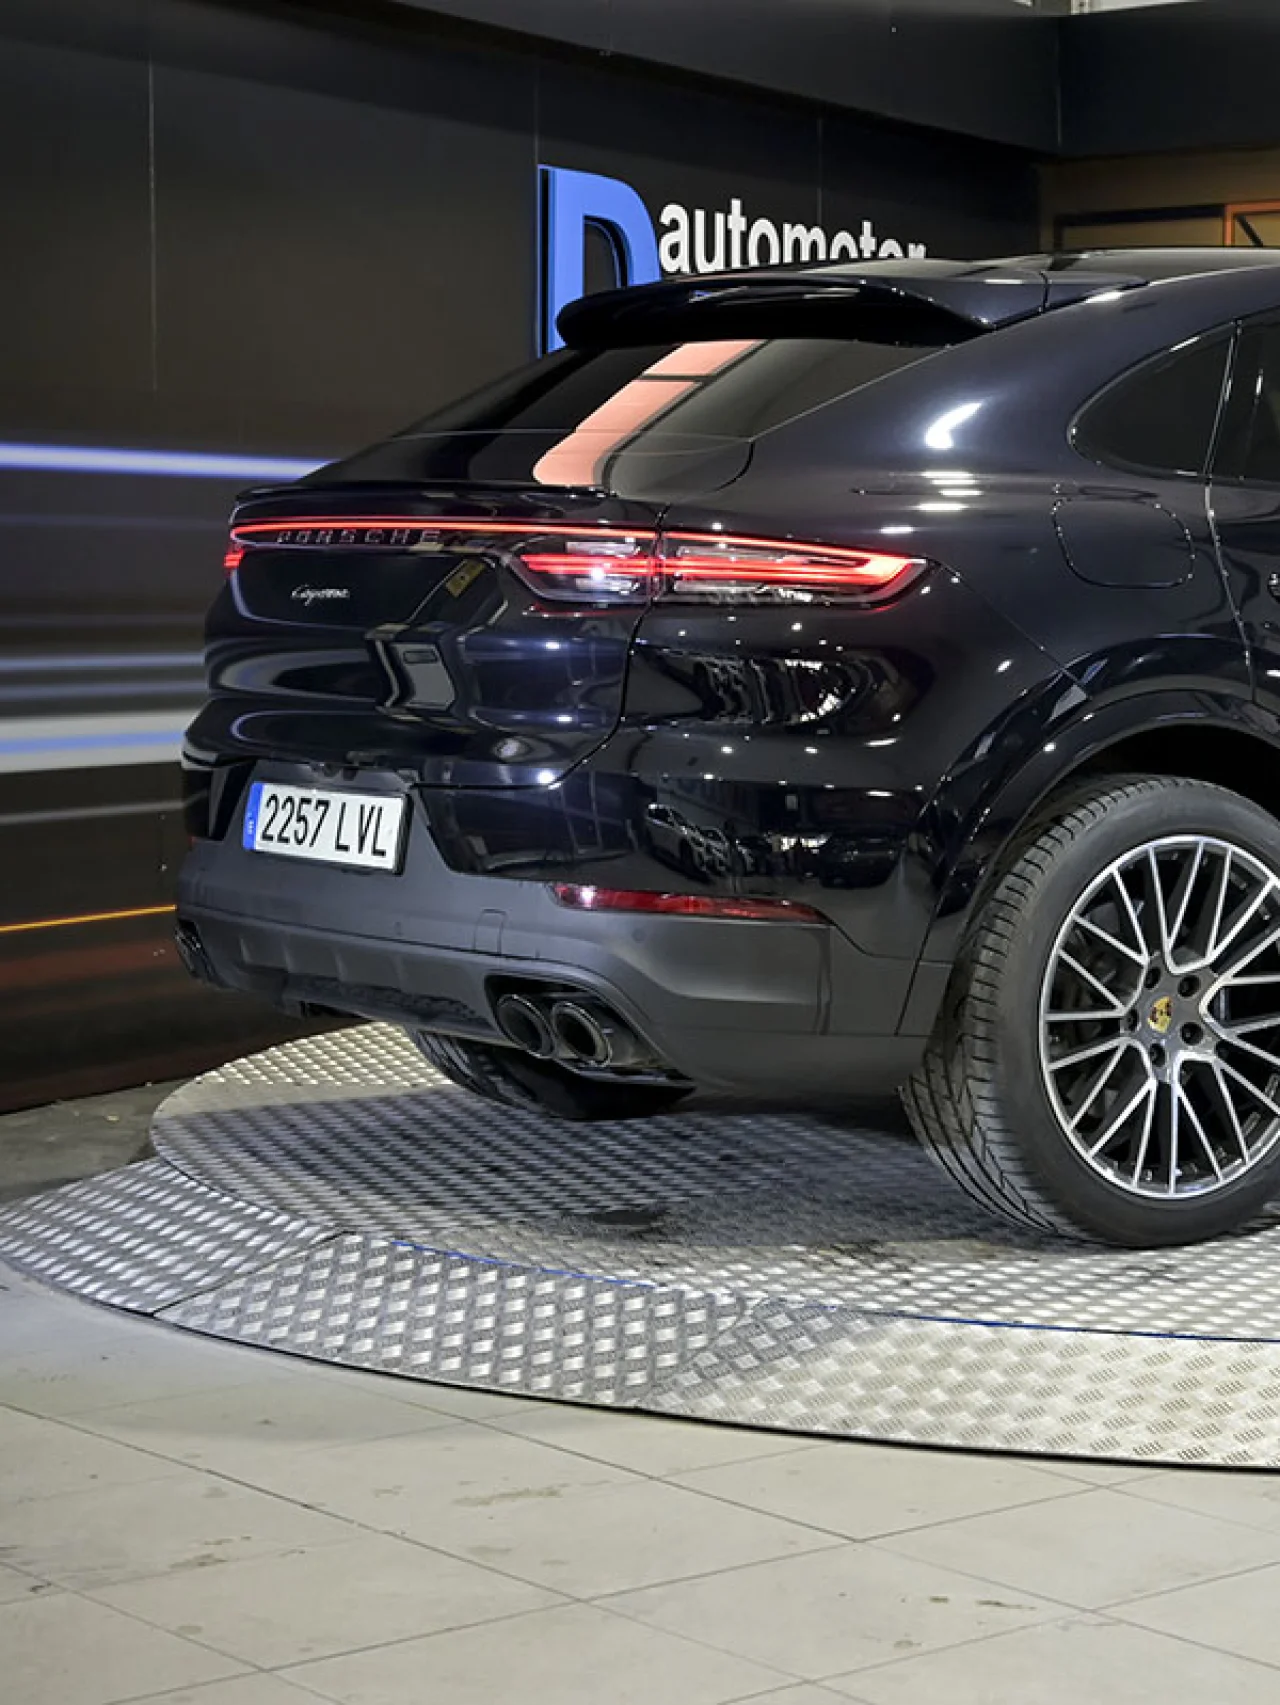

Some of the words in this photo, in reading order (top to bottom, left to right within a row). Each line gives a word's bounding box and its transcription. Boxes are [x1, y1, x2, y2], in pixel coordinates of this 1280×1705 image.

[659, 198, 927, 274] automot
[276, 529, 441, 544] PORSCHE
[261, 793, 331, 848] 2257
[335, 802, 387, 857] LVL
